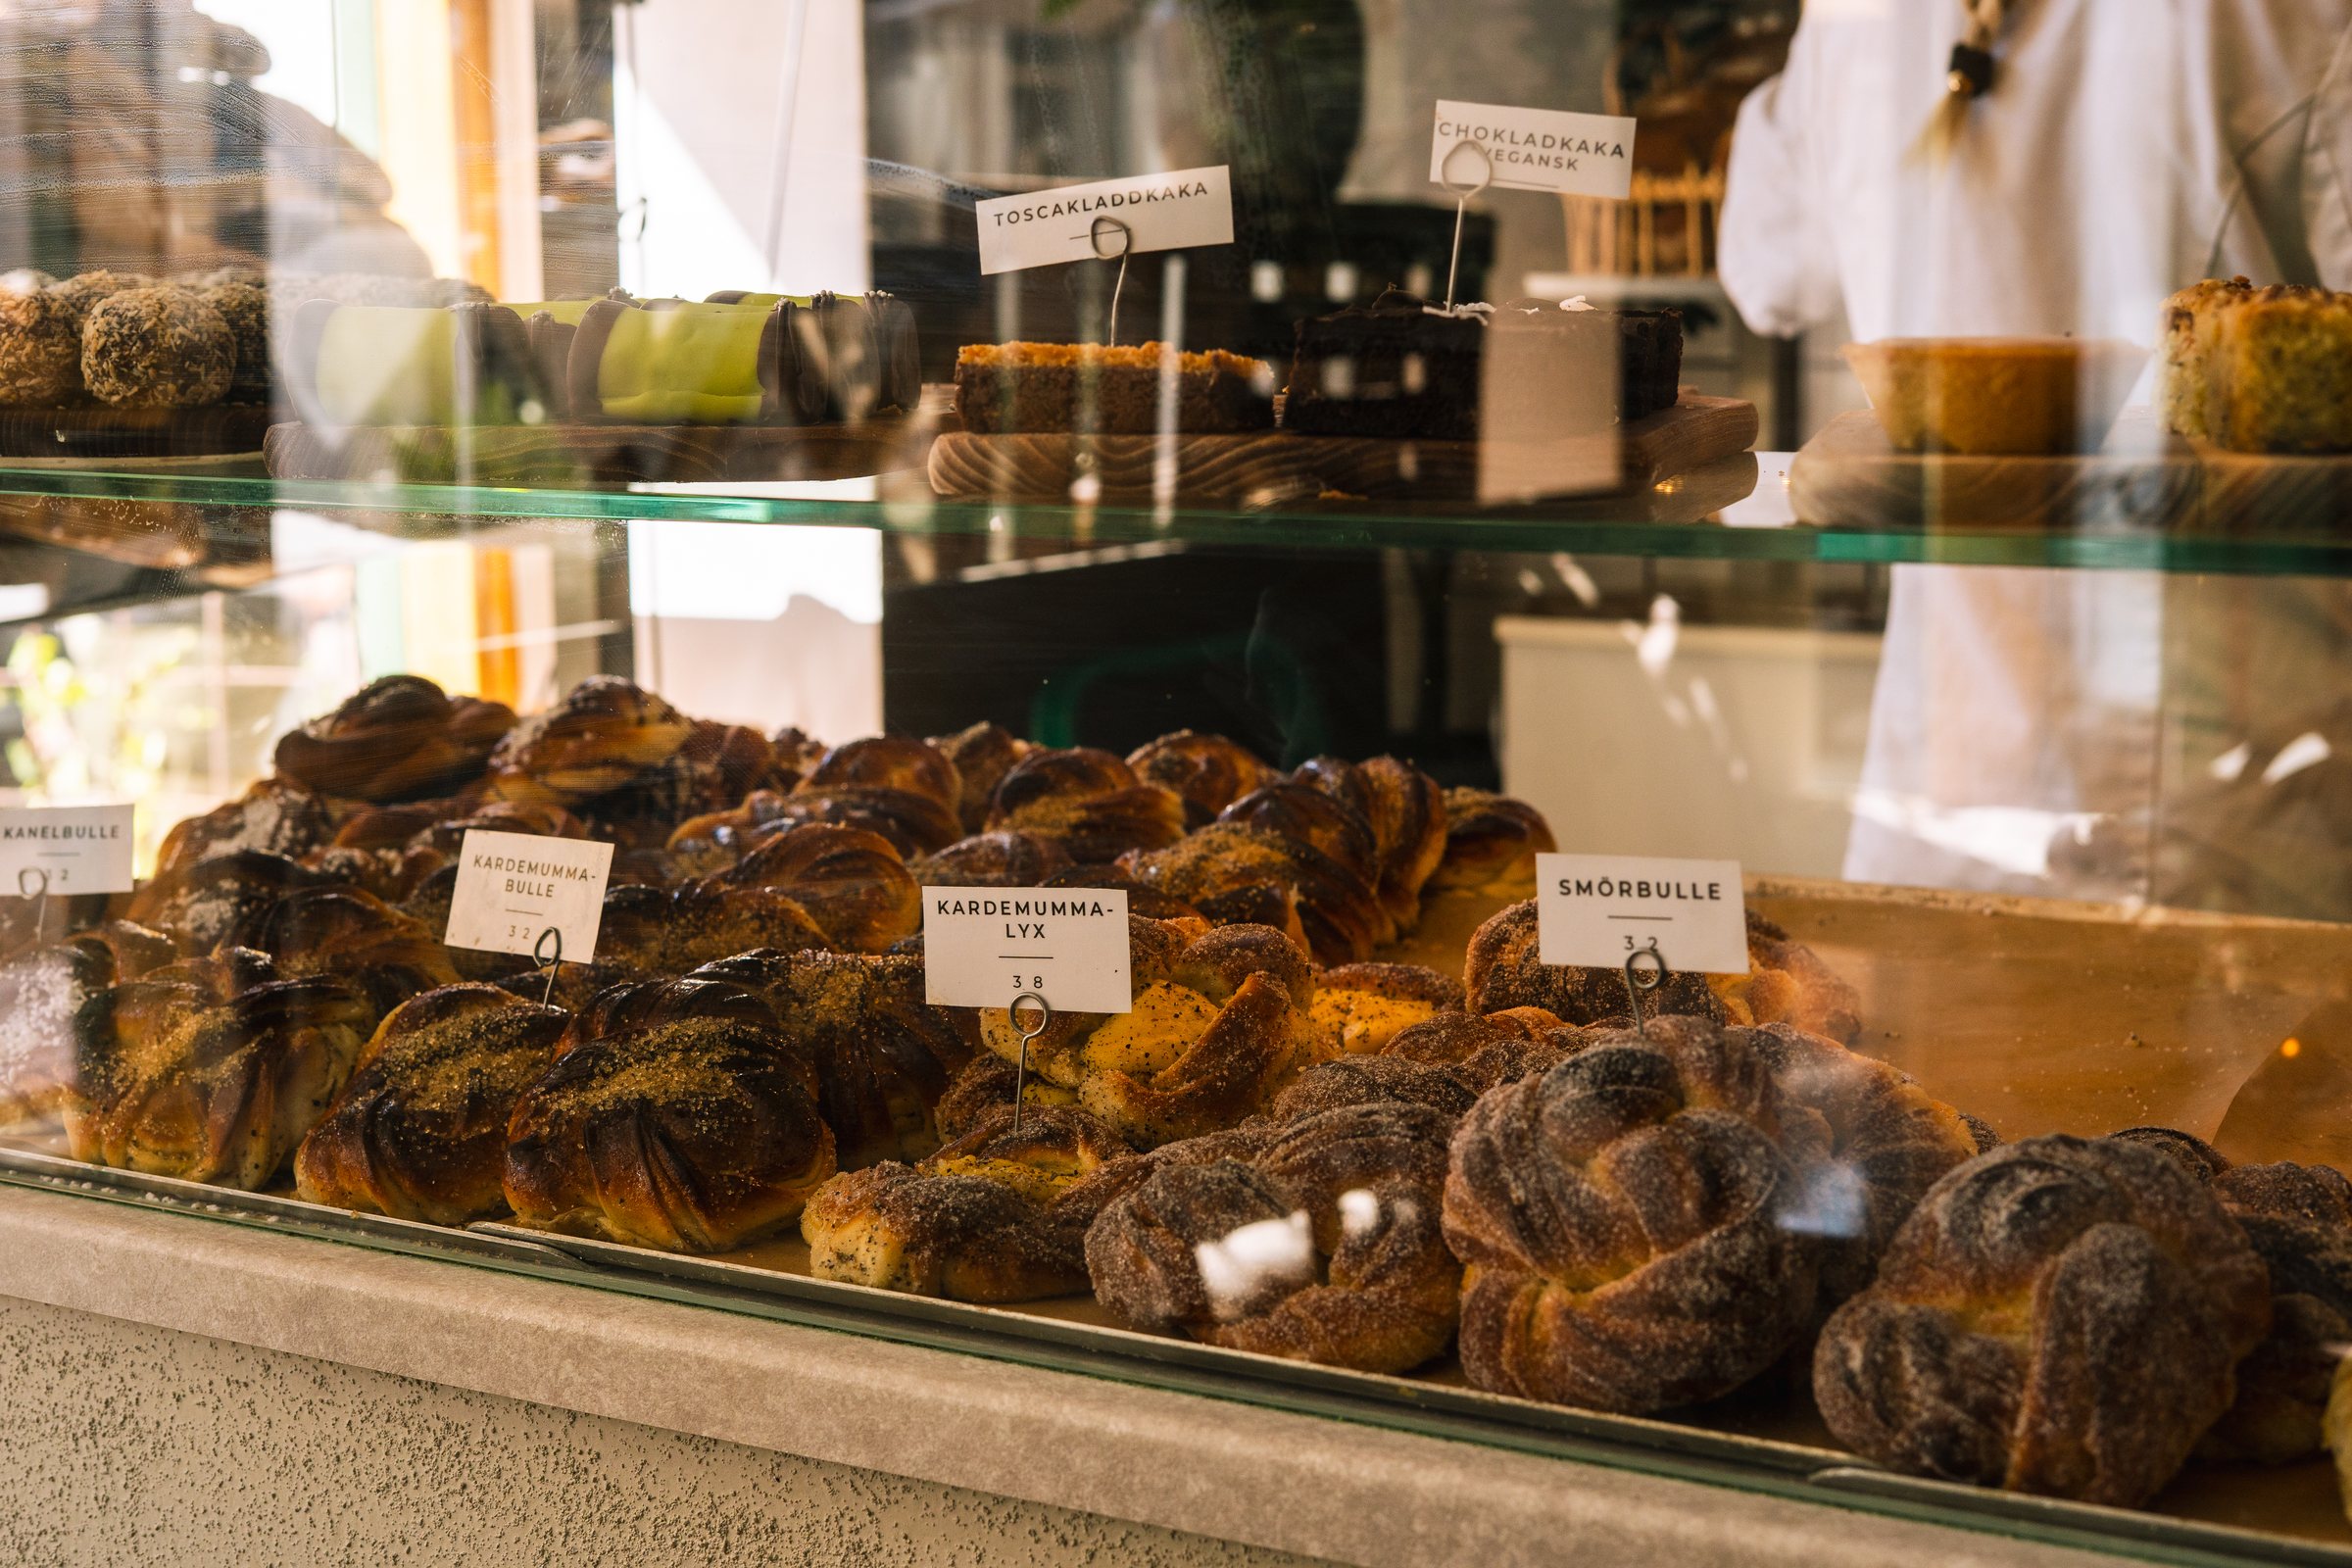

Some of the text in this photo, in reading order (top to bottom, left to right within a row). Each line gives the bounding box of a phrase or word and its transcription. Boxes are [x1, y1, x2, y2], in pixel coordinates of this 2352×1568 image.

[1439, 122, 1625, 159] CHOKLADKAKA
[994, 181, 1207, 226] TOSCAKLADDKAKA
[4, 824, 120, 839] KANELBULLE
[473, 855, 596, 882] KARDEMUMMA-
[505, 879, 555, 898] BULLE
[1559, 877, 1721, 900] SMÖRBULLE
[938, 900, 1113, 916] KARDEMUMMA-
[1005, 923, 1045, 938] LYX
